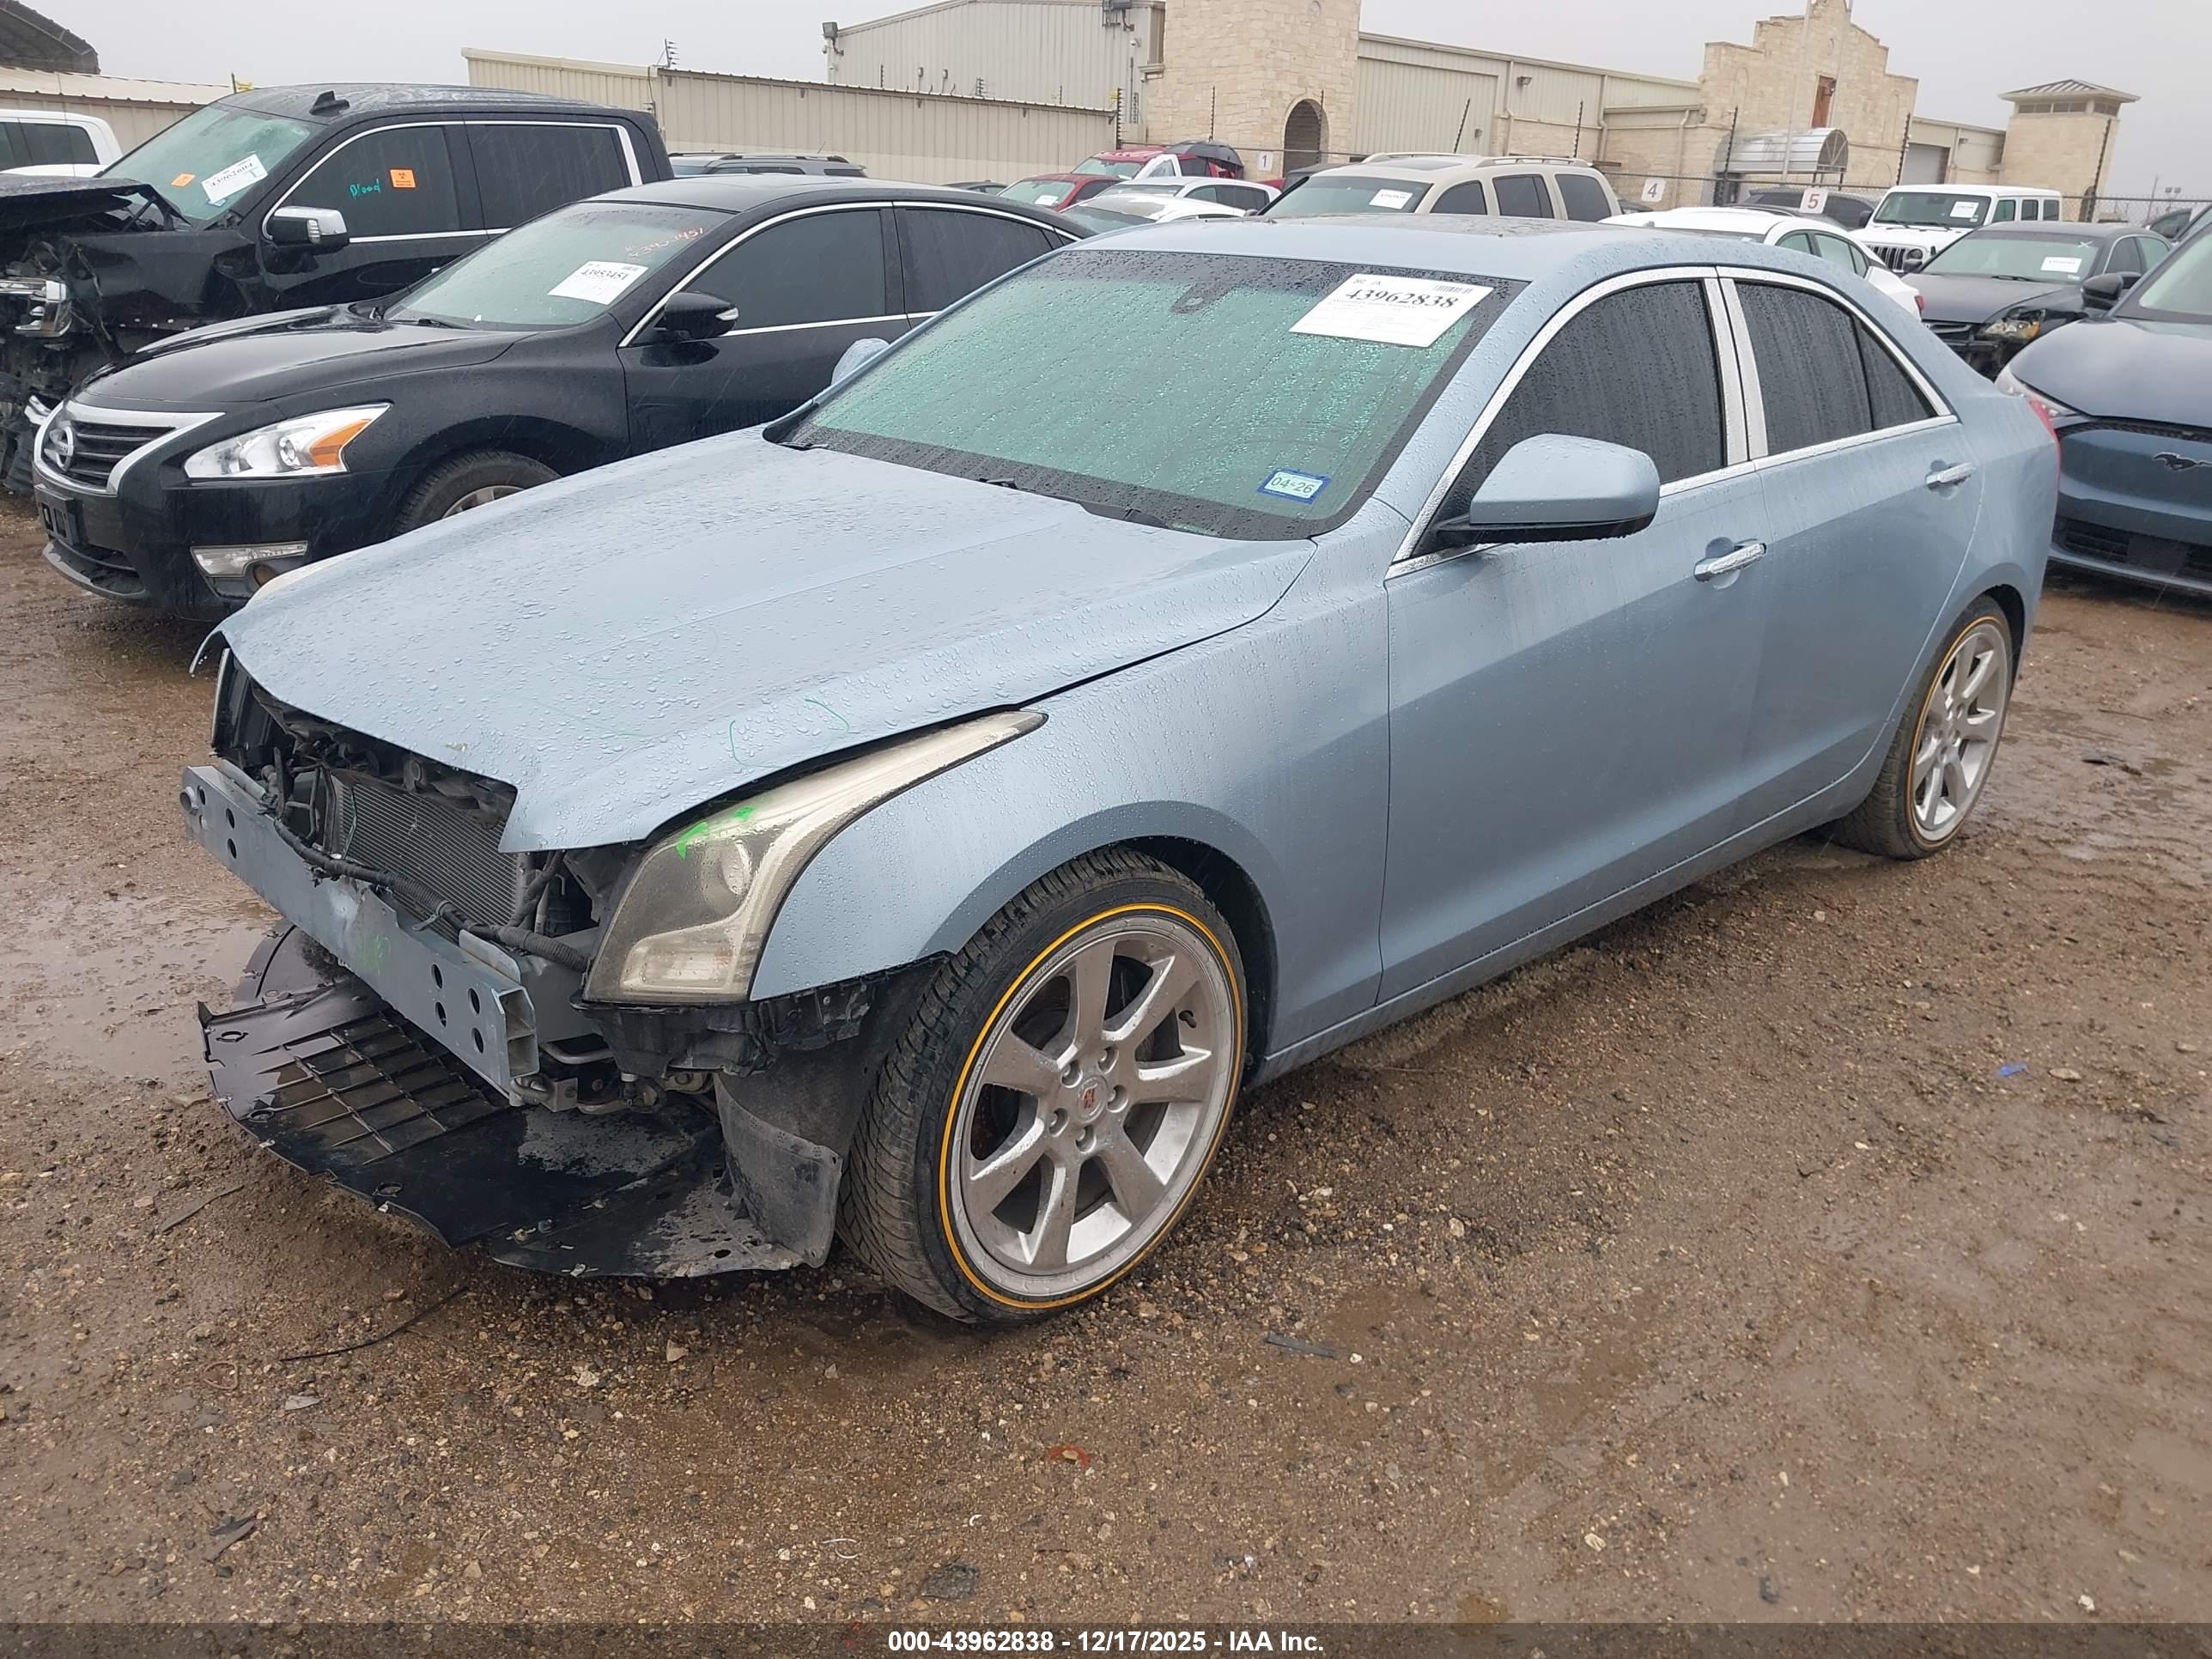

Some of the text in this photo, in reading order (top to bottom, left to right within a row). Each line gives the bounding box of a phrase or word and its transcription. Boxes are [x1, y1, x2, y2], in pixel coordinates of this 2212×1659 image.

[1261, 155, 1267, 167] 1
[1646, 183, 1658, 198] 4
[1807, 193, 1820, 210] 5
[1345, 289, 1459, 308] 43962838
